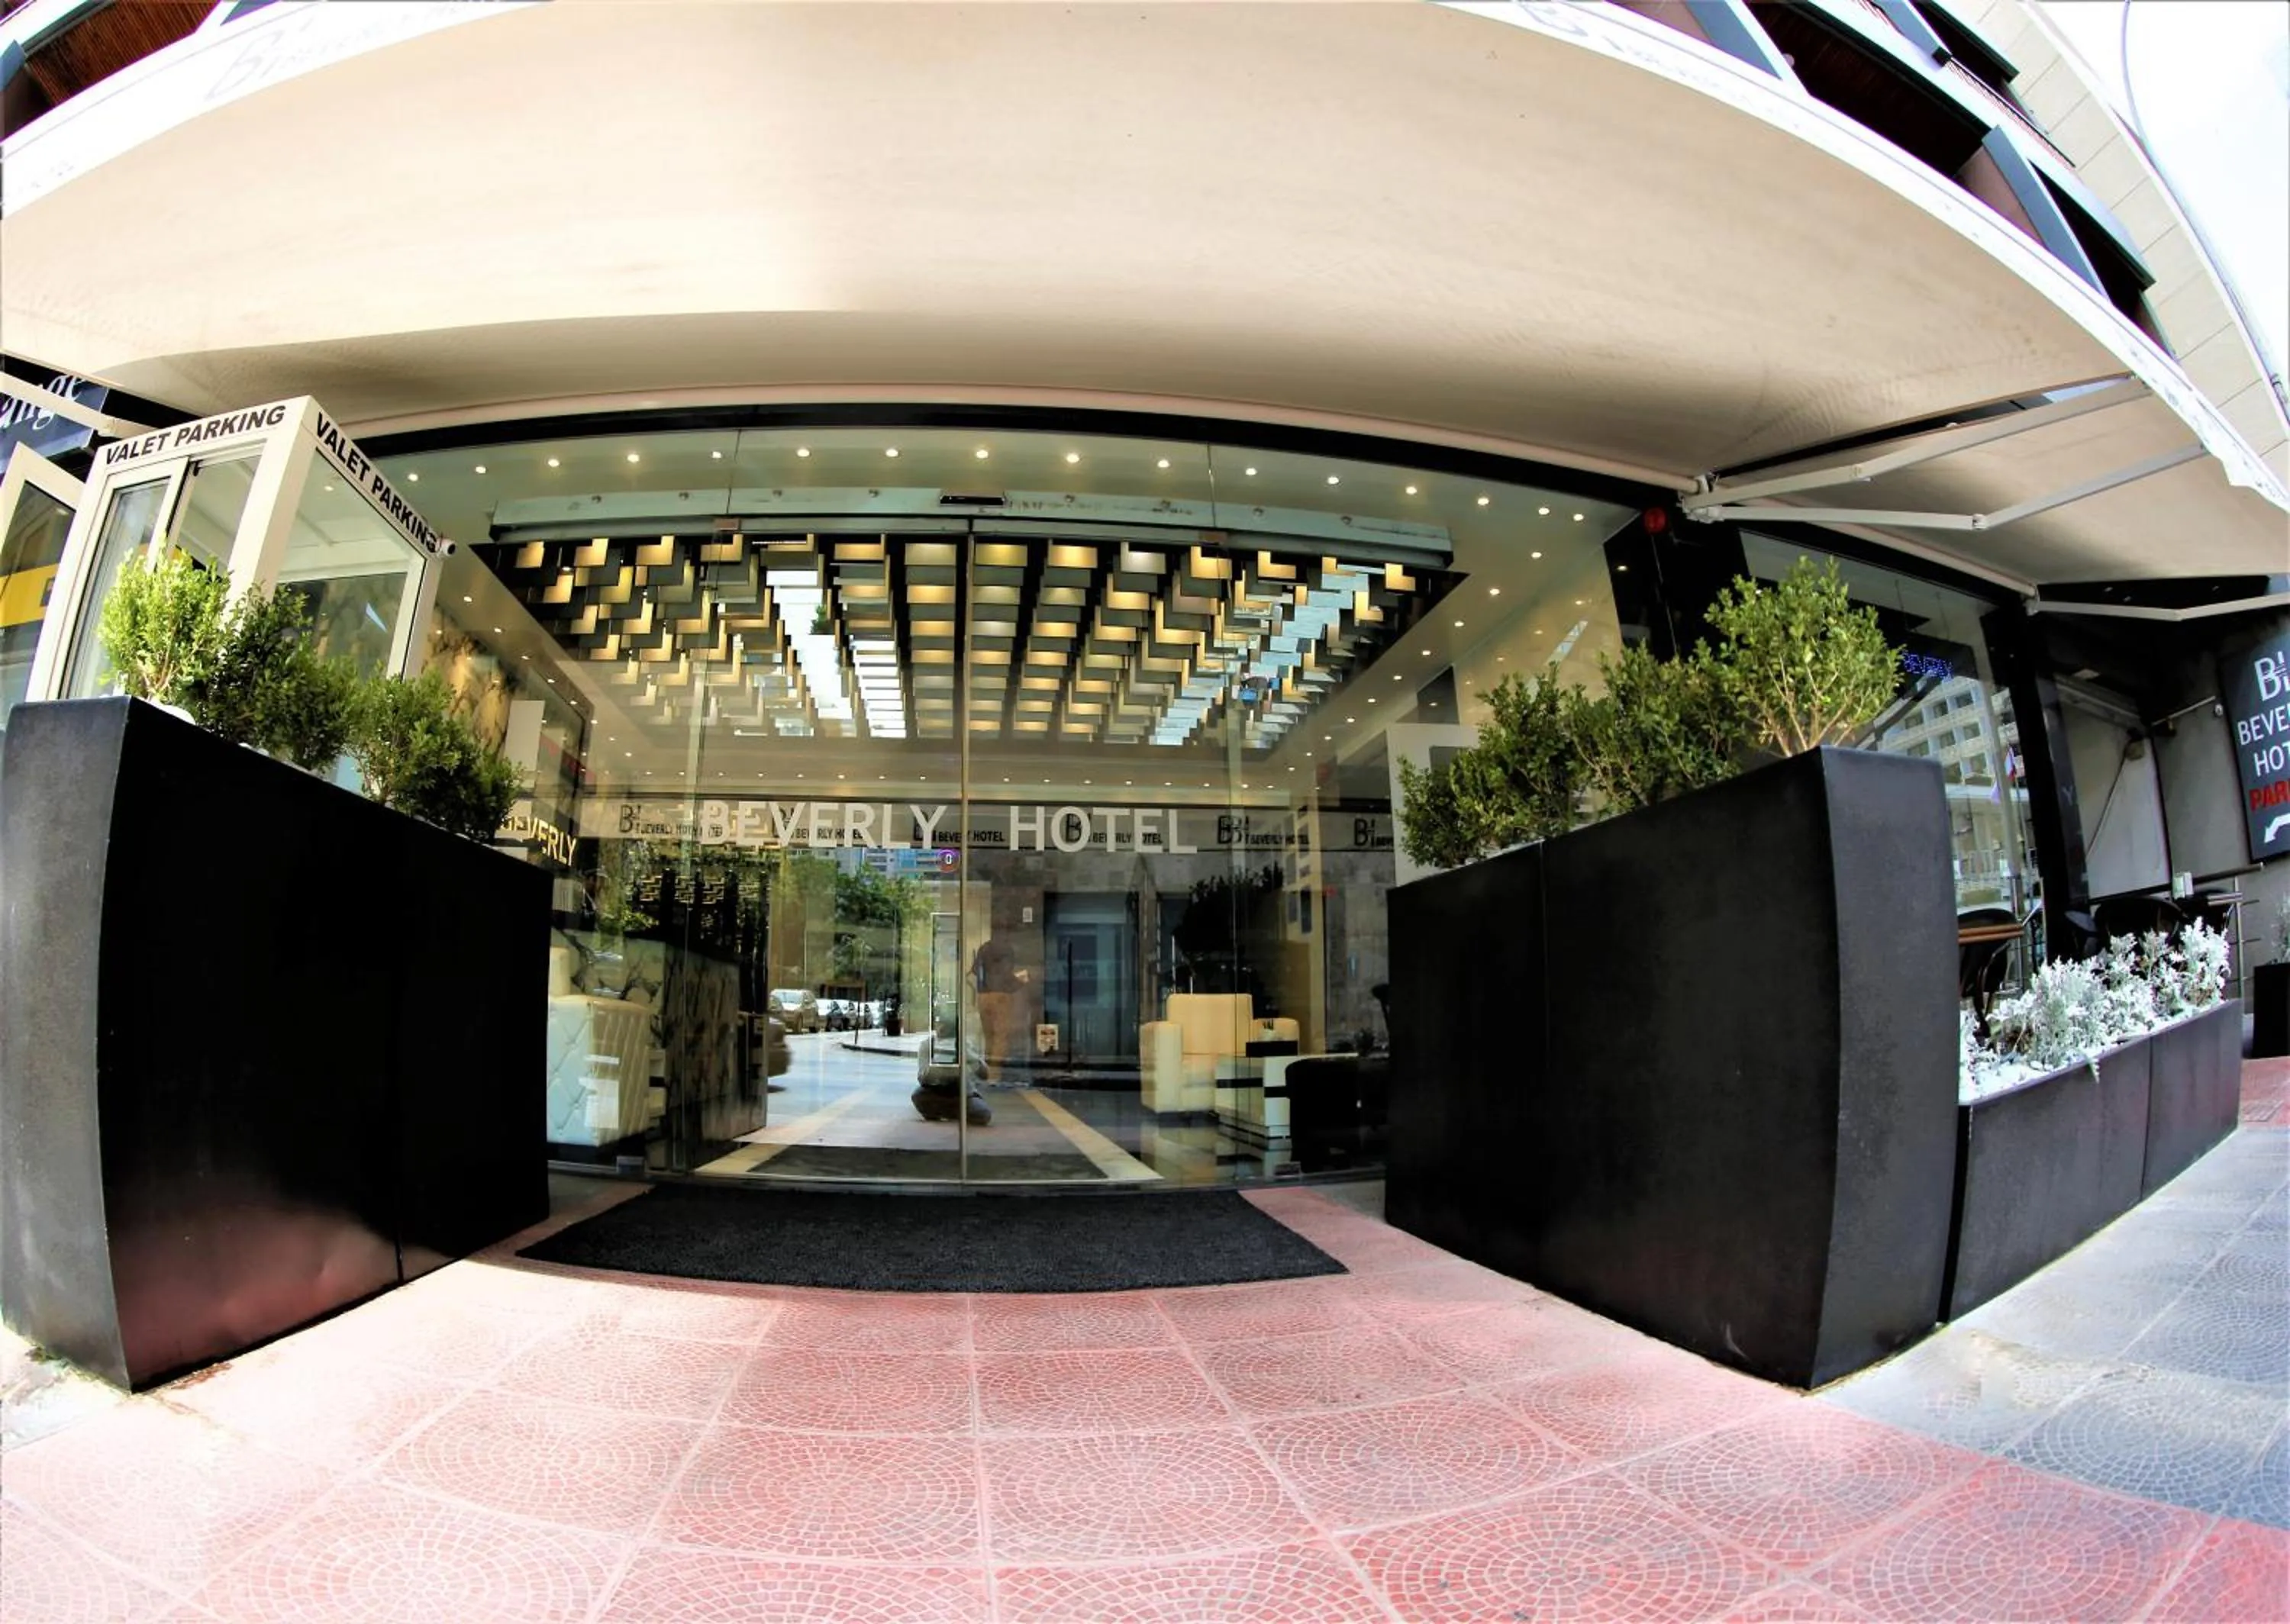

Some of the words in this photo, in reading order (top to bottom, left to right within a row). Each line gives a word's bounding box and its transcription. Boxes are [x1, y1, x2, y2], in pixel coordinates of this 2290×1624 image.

[106, 432, 172, 465] VALET
[174, 405, 286, 447] PARKING
[316, 411, 370, 482] VALET
[371, 475, 437, 553] PARKING
[2237, 703, 2290, 746] BEVE
[2249, 778, 2290, 812] PAR
[700, 799, 947, 849] BEVERLY
[1010, 805, 1198, 855] HOTEL
[973, 830, 1006, 842] HOTEL
